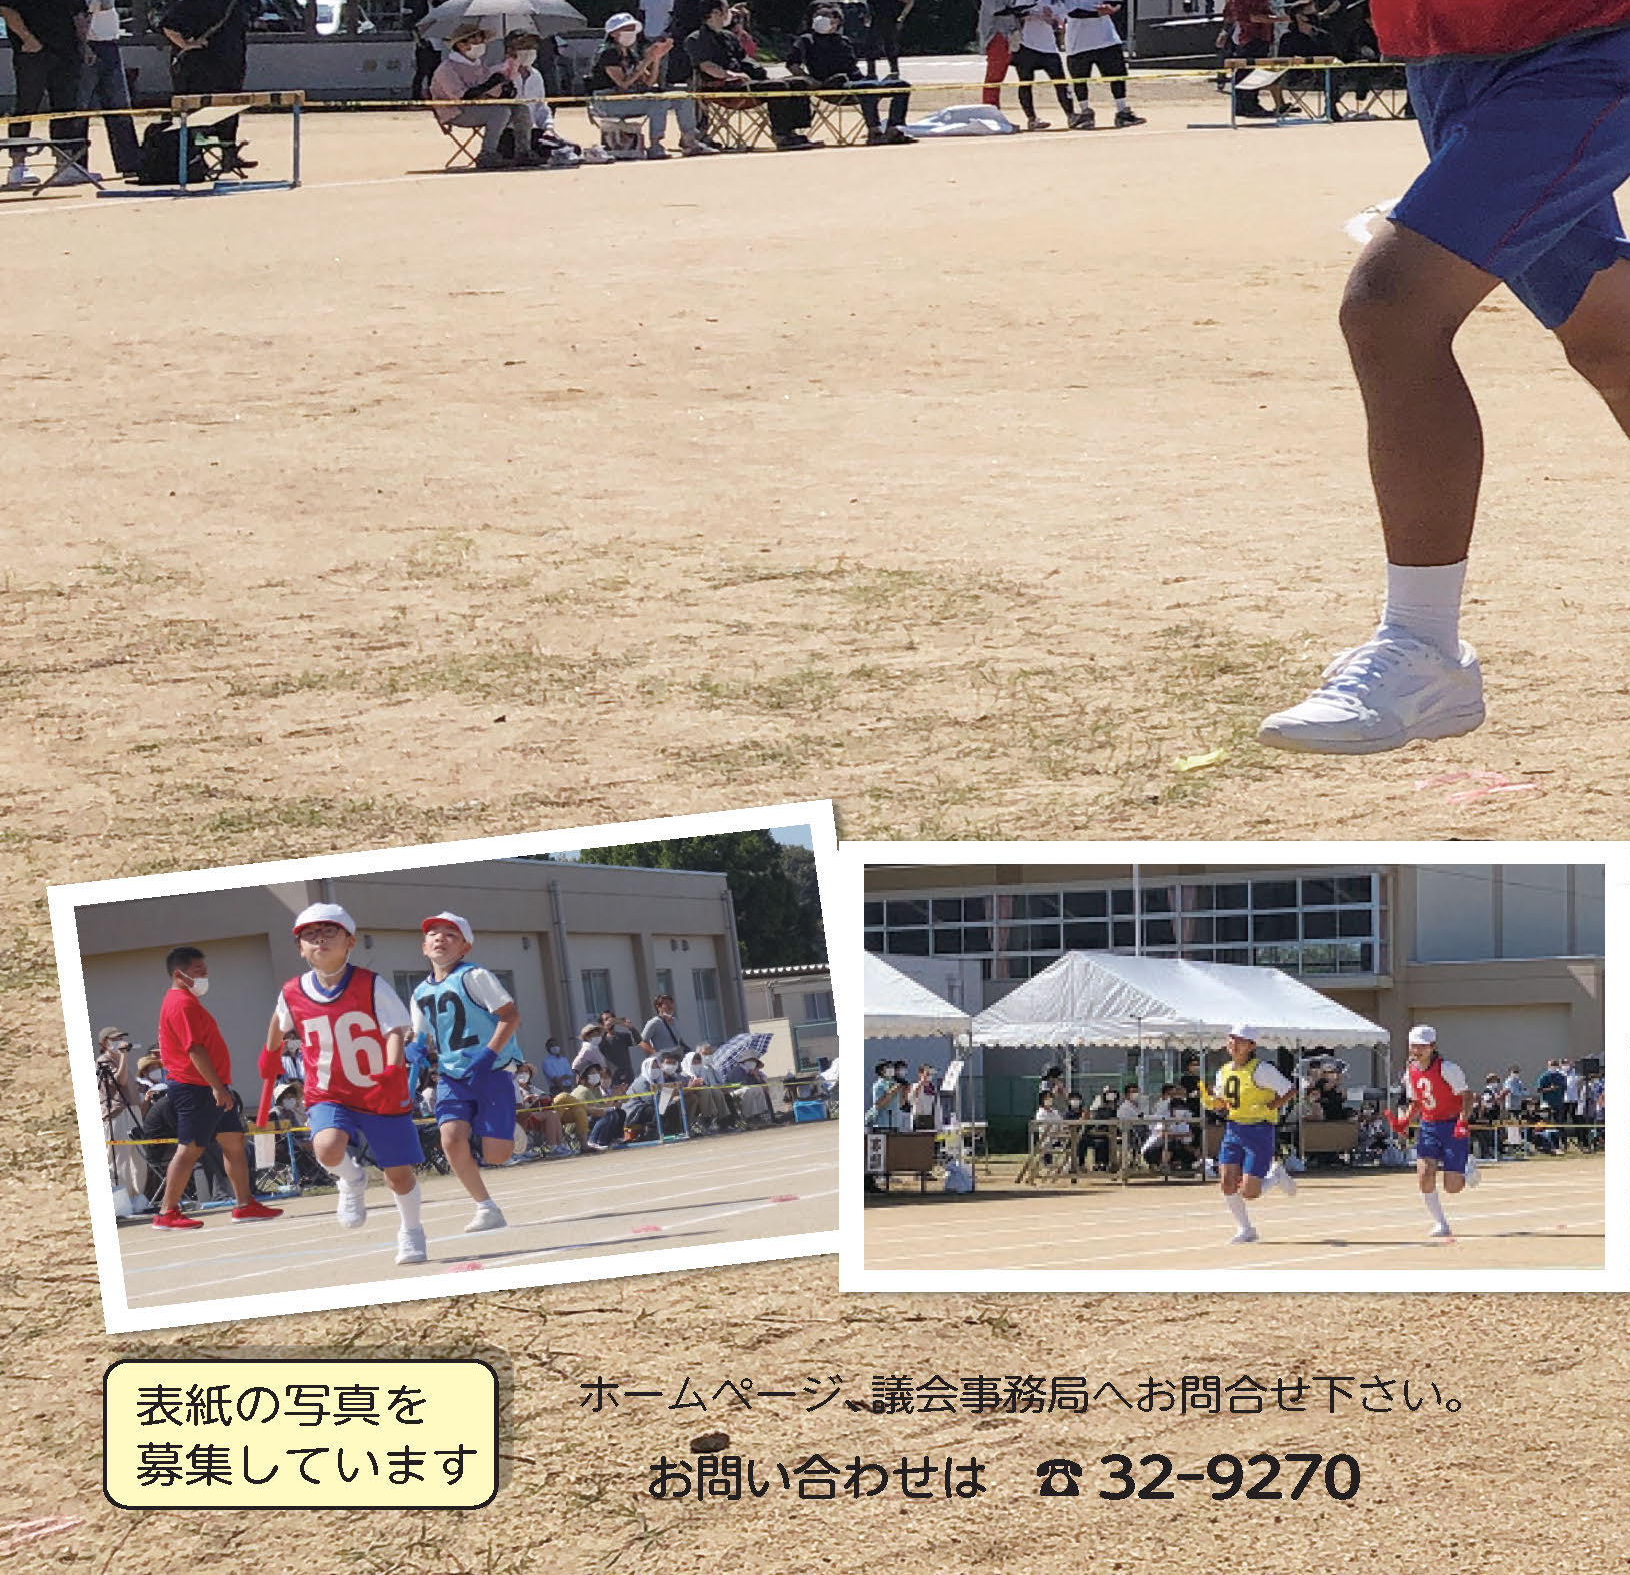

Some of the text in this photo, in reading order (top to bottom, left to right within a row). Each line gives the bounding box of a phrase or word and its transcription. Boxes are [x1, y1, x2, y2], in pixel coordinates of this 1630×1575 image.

[302, 1011, 384, 1091] 76
[1224, 1075, 1241, 1109] 9
[1416, 1077, 1438, 1109] 3
